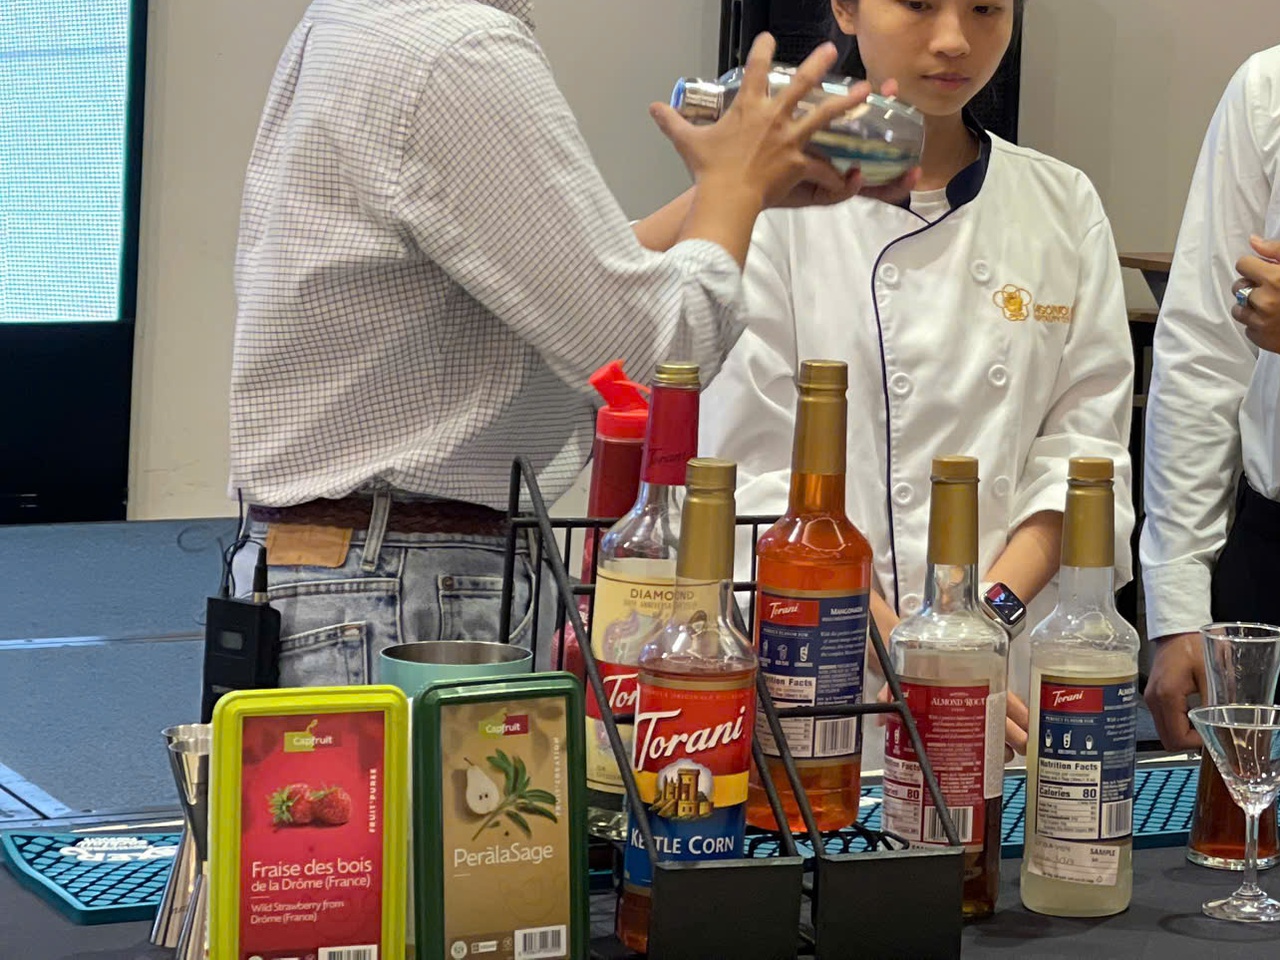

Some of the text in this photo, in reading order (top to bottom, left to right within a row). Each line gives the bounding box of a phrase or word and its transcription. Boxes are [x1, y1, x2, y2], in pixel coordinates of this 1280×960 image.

[630, 588, 694, 601] DIAMOND
[770, 602, 799, 619] Torani
[603, 673, 638, 708] Tor
[931, 697, 963, 707] ALMOND
[1052, 690, 1084, 707] Torani
[634, 682, 747, 772] Torani
[1074, 762, 1099, 771] Facts
[907, 788, 920, 800] 80
[1039, 787, 1071, 798] Calories
[1082, 788, 1098, 799] 80
[631, 827, 735, 855] KETLE CORN
[252, 857, 373, 878] Fraise des bois
[250, 881, 267, 892] de
[268, 880, 280, 892] la
[325, 874, 371, 890] (France)
[251, 900, 345, 913] Wild Strawberry from
[283, 913, 318, 924] (France)
